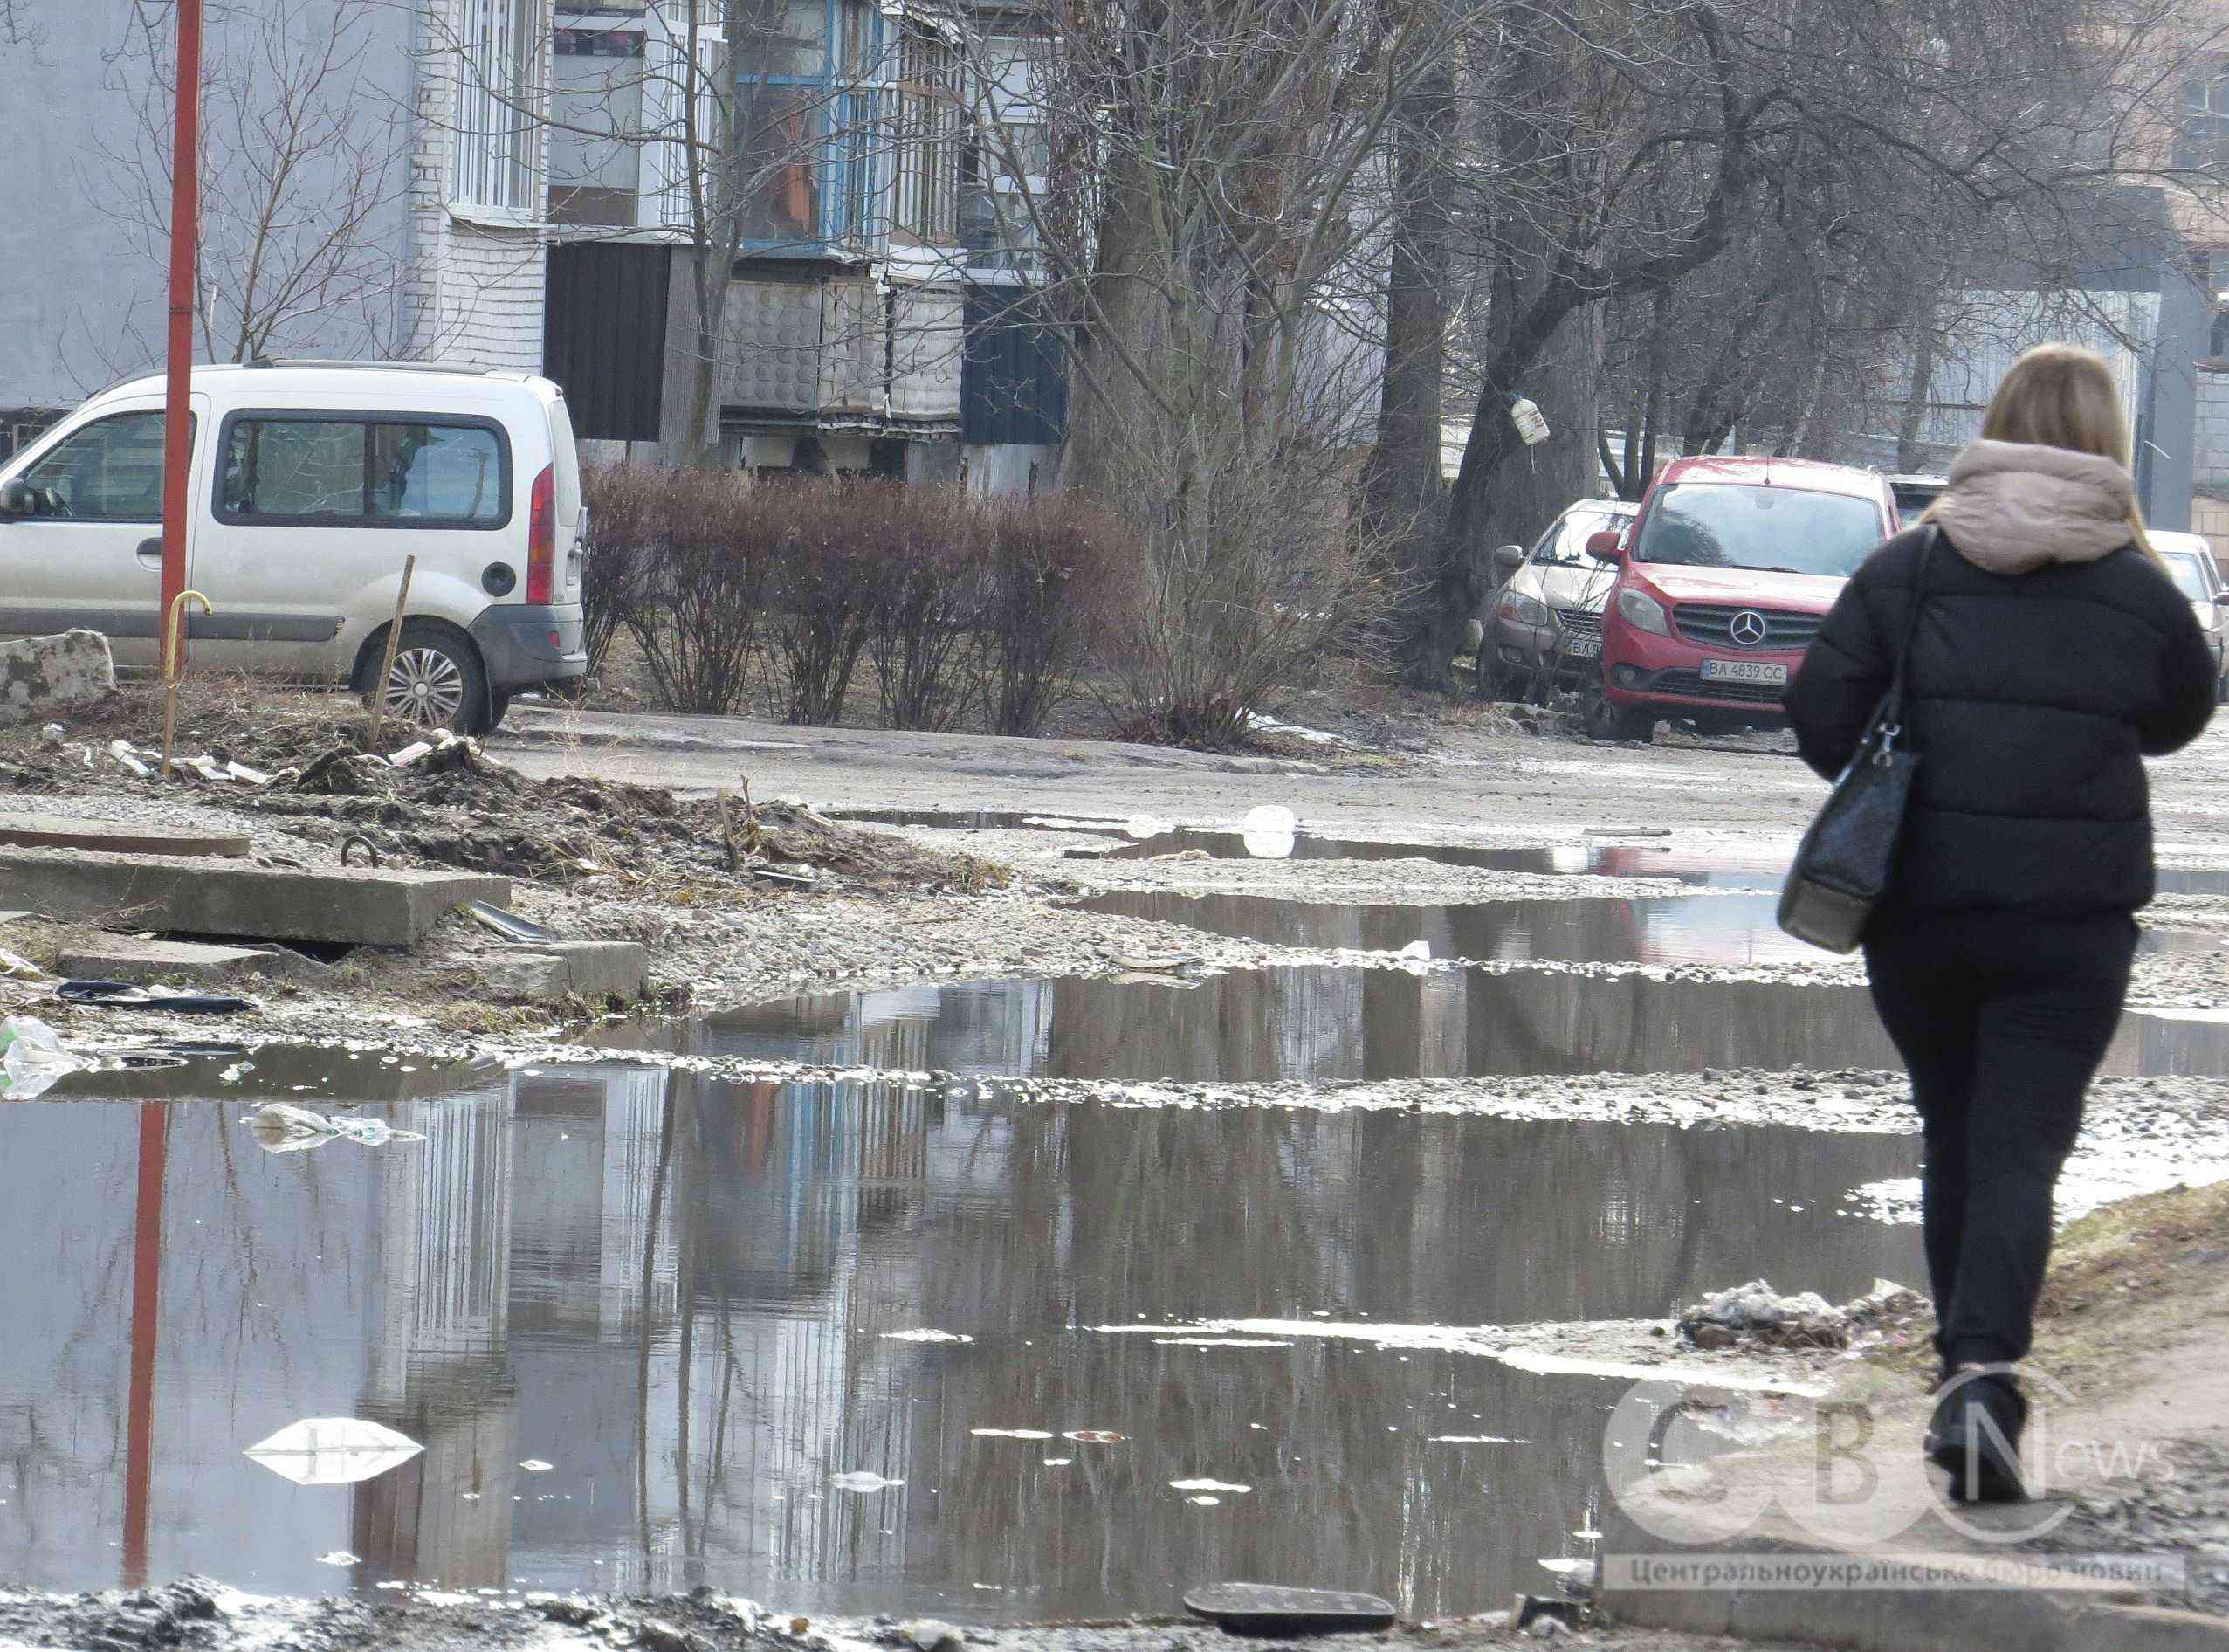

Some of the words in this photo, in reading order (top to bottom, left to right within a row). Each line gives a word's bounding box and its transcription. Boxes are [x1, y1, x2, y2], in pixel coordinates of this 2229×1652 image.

[1710, 662, 1727, 676] BA
[1730, 664, 1761, 678] 4839
[1764, 666, 1783, 679] CC
